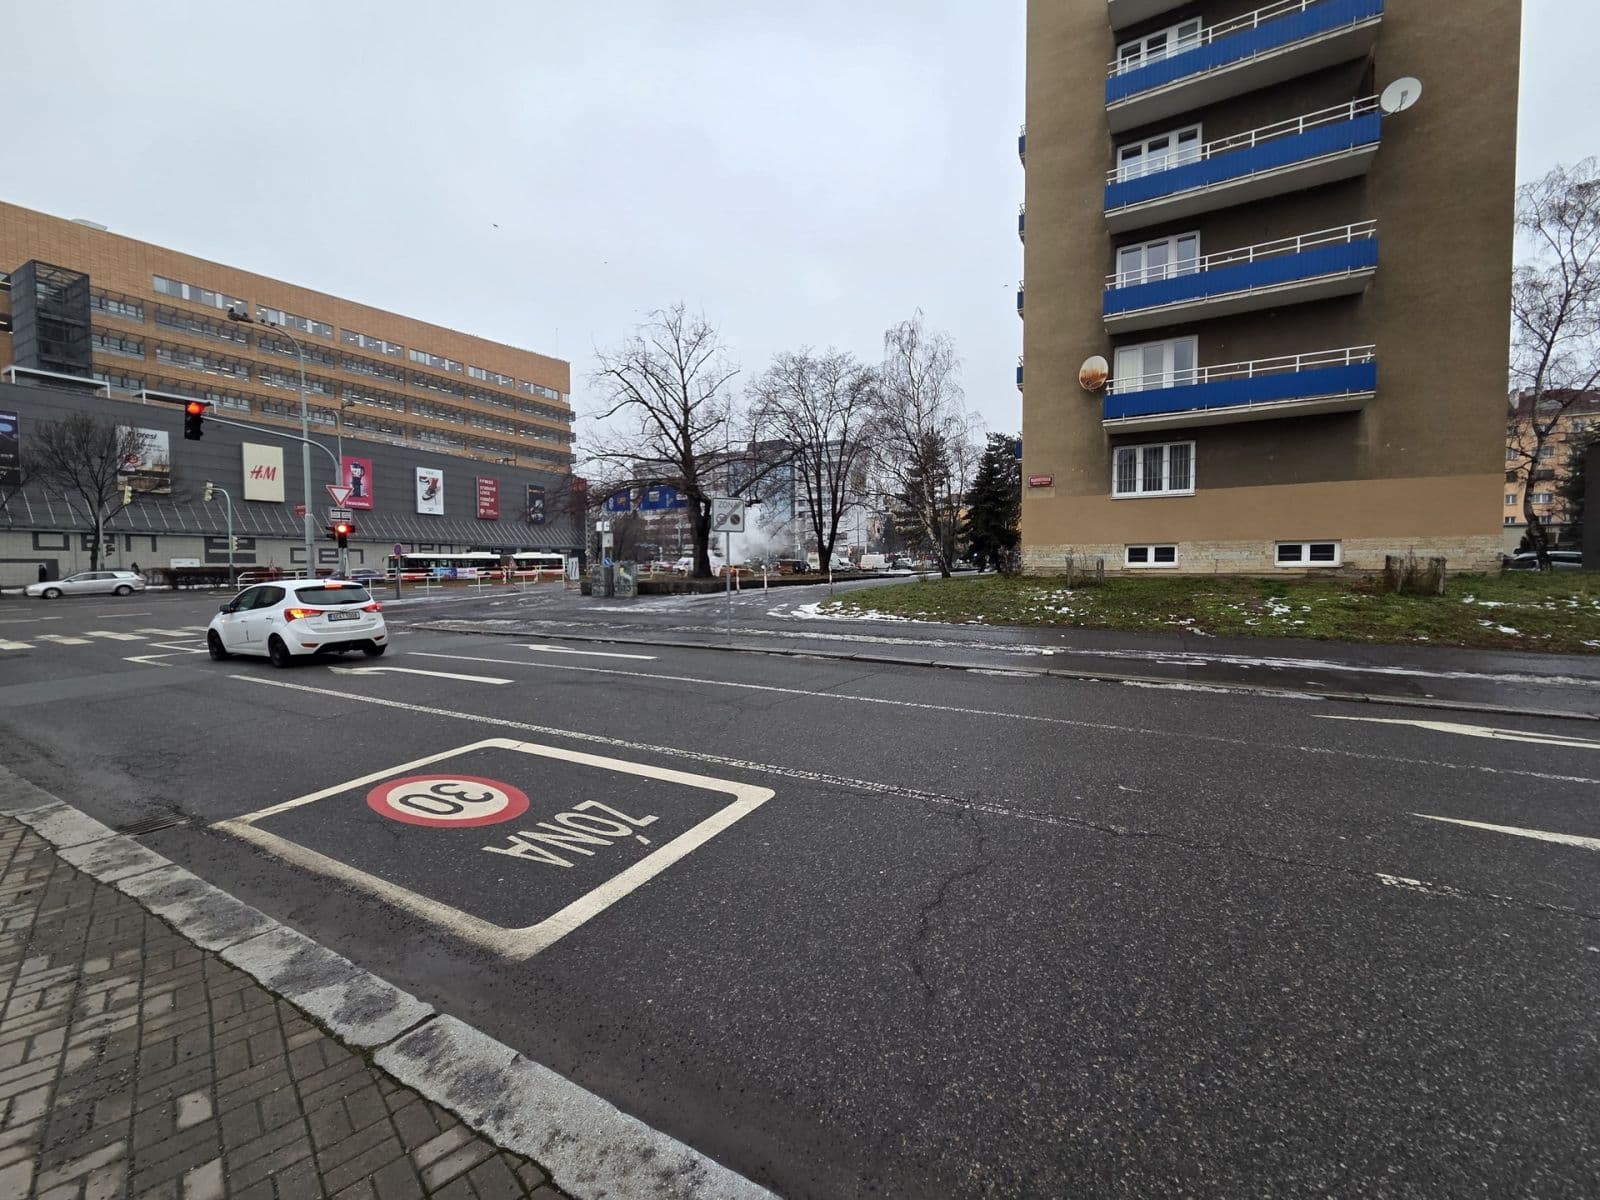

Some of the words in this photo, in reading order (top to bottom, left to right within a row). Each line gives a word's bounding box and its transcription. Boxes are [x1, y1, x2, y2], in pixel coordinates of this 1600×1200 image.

[250, 465, 276, 481] H&M
[398, 783, 495, 815] 30
[481, 800, 660, 868] ZÓNA
